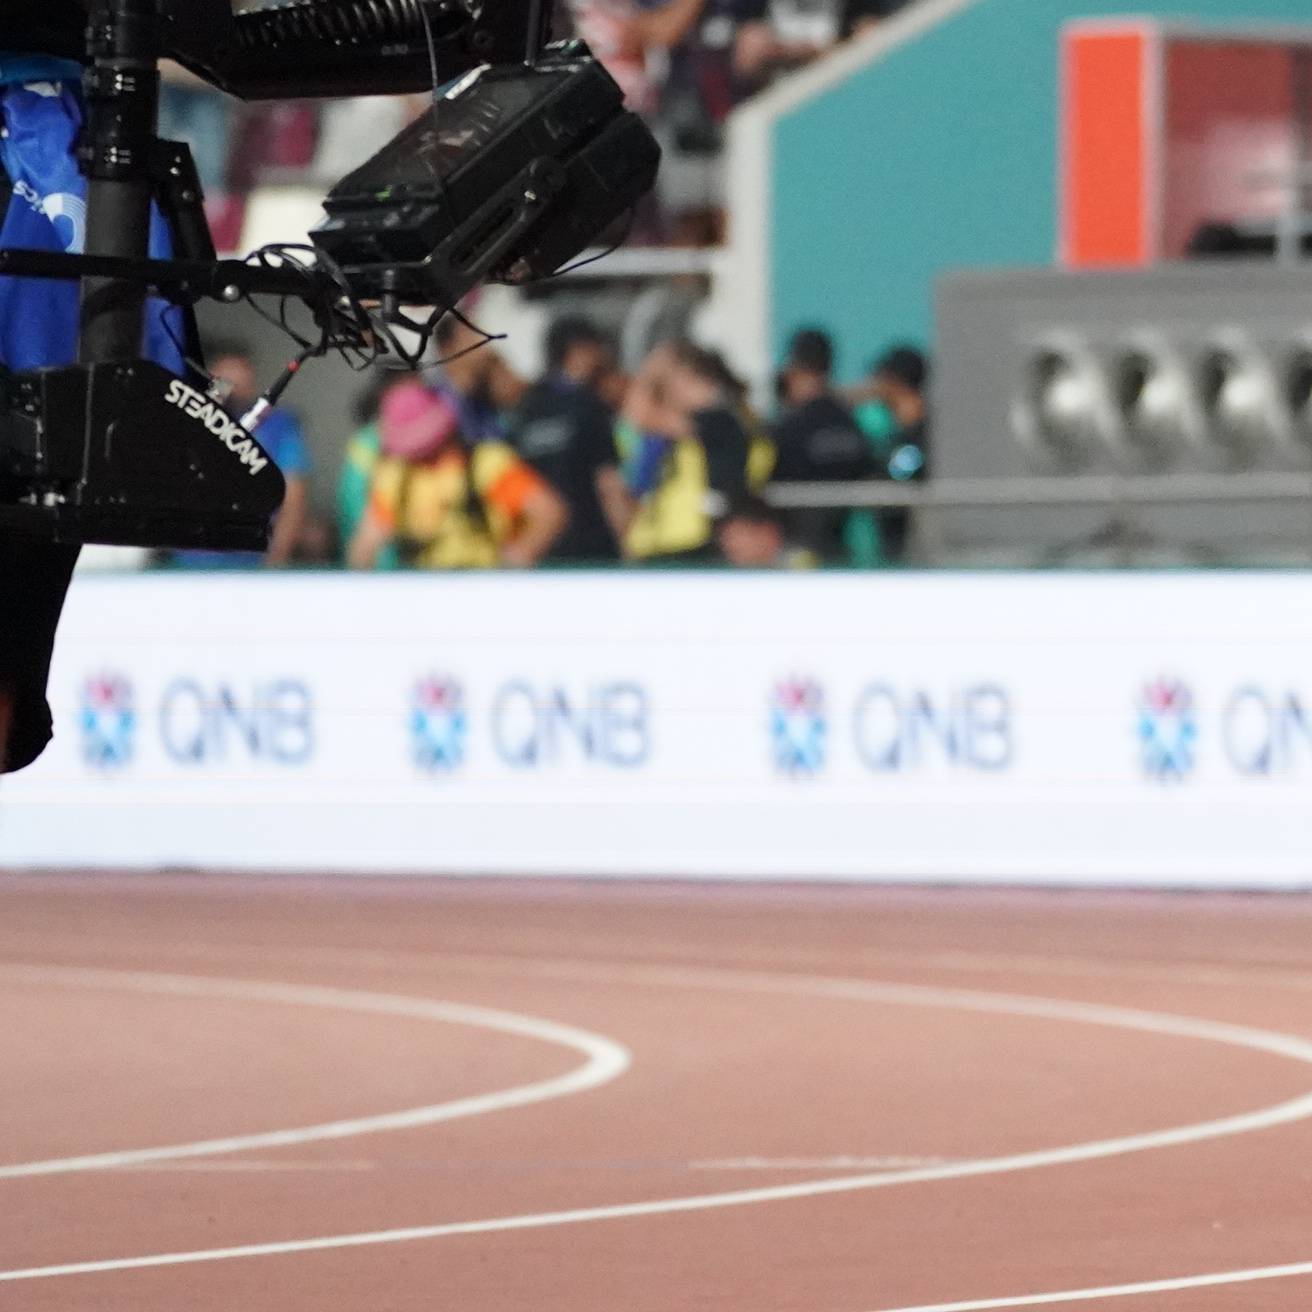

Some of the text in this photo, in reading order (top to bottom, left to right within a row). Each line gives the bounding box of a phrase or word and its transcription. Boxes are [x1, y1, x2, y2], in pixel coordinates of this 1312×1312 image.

[164, 379, 269, 476] STEADICAM
[157, 674, 319, 767] QNB
[490, 676, 652, 770] QNB
[853, 678, 1018, 774] QNB
